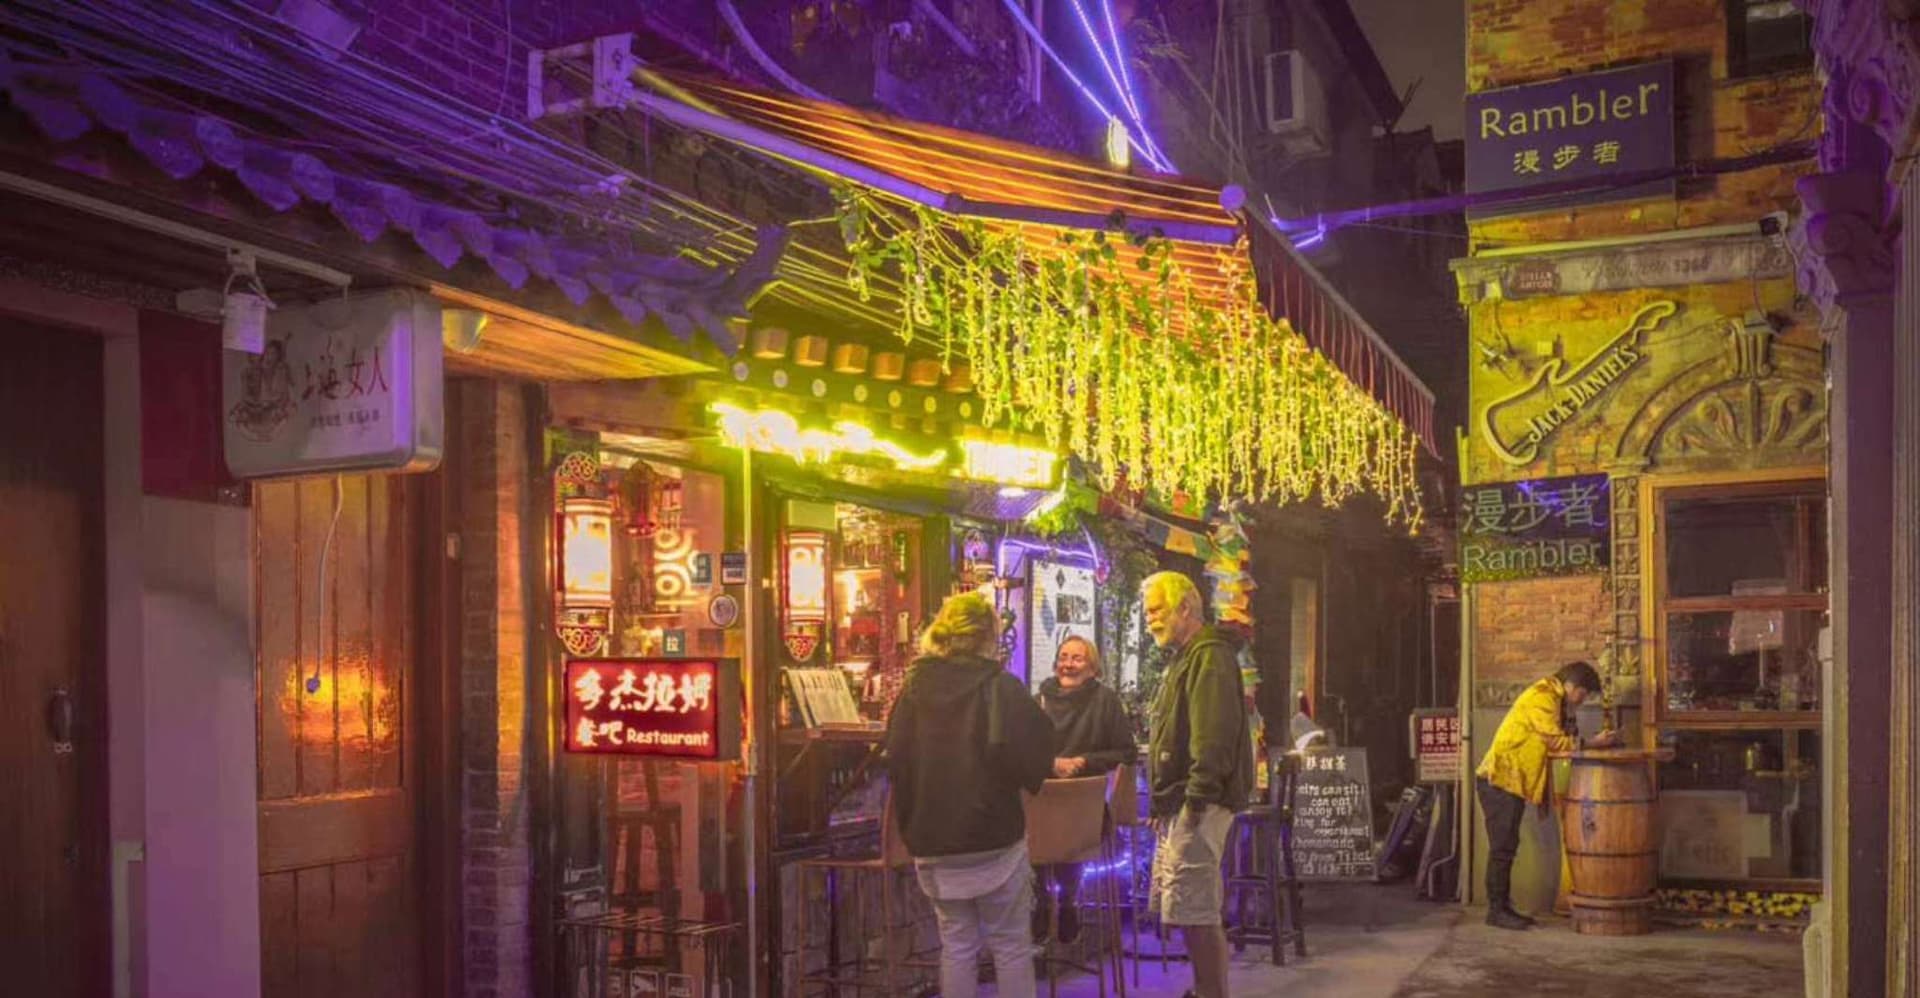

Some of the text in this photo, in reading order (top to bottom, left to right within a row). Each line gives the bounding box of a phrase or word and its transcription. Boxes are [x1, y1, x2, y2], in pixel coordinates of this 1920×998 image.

[1479, 81, 1659, 140] Rambler
[1513, 141, 1621, 174] 漫步者
[1462, 481, 1600, 534] 漫步者
[1463, 538, 1601, 571] Rambler
[626, 727, 711, 747] Restaurant
